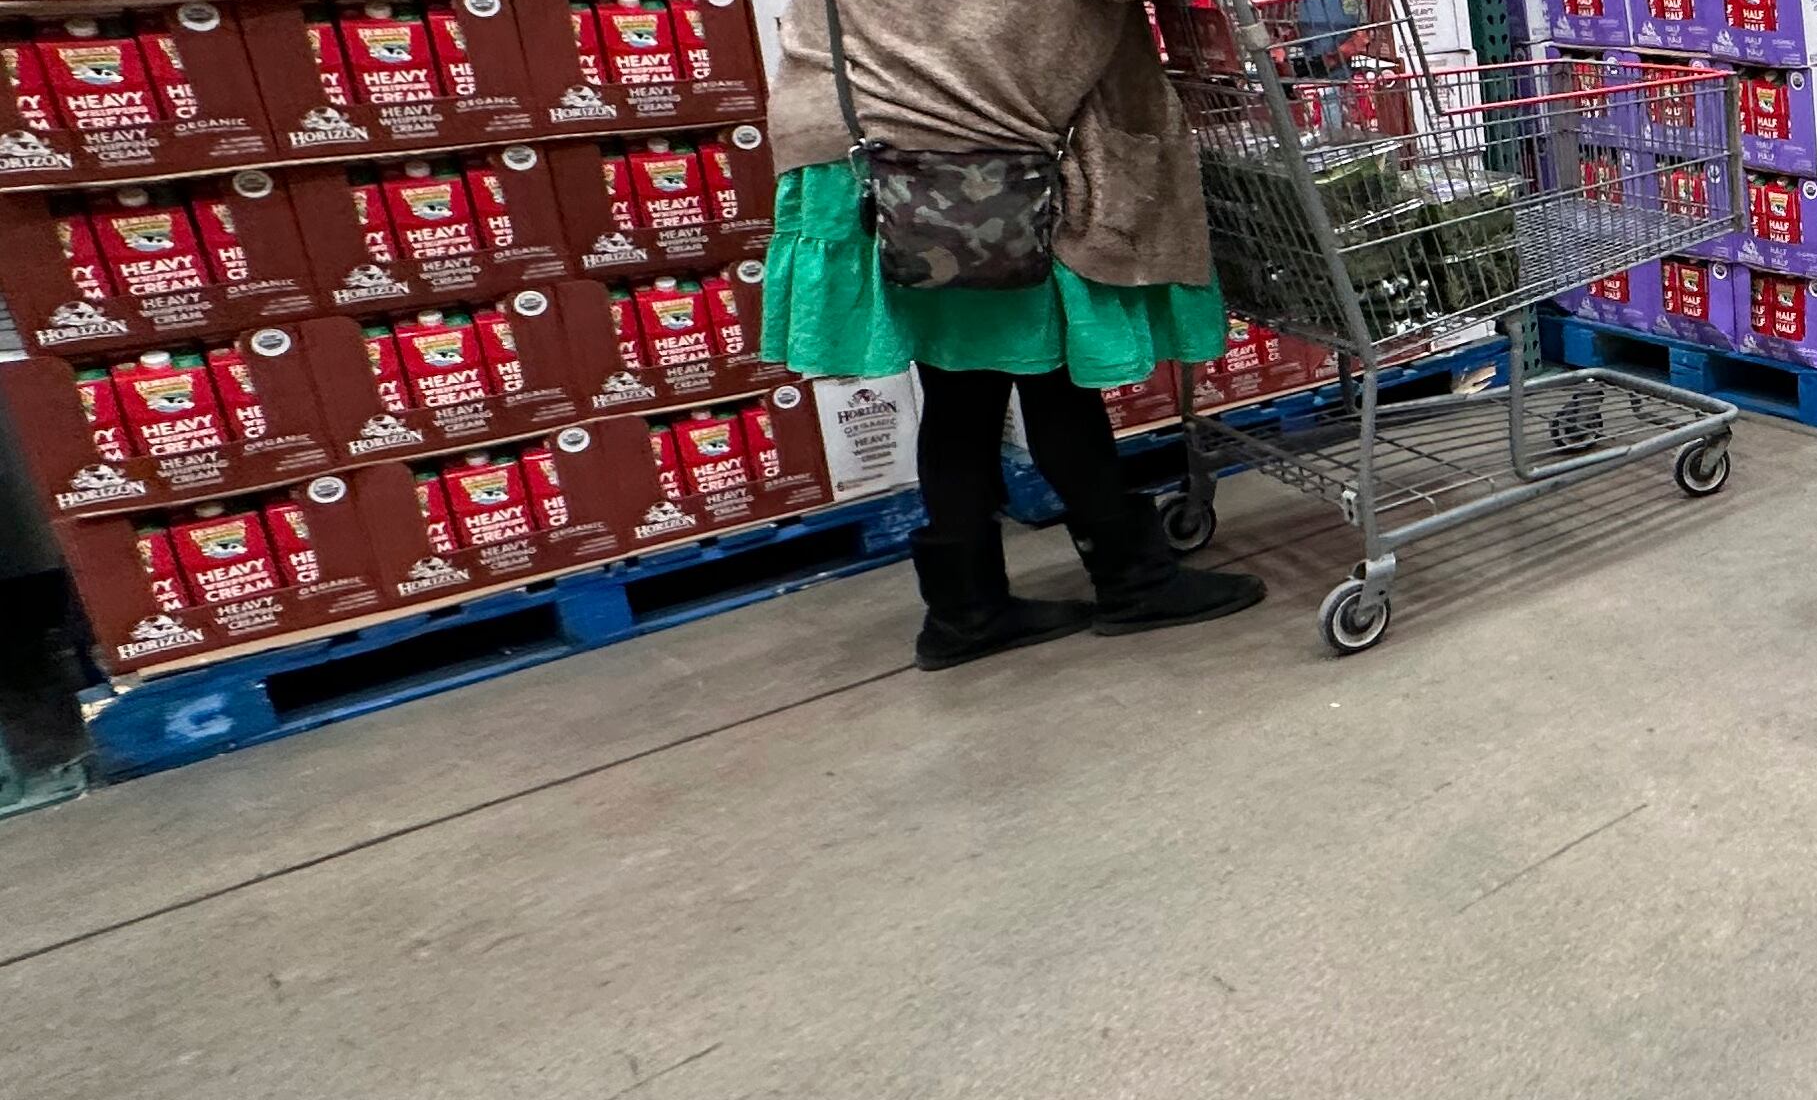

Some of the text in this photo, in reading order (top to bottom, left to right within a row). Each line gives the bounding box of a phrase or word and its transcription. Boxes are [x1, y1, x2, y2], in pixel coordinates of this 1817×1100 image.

[1665, 12, 1683, 20] HALF
[1743, 8, 1765, 20] HALF
[1744, 22, 1765, 32] HALF
[615, 53, 671, 68] HEAVY
[363, 69, 428, 85] HEAVY
[370, 91, 434, 103] CREAM
[629, 86, 674, 98] HEAVY
[66, 91, 145, 110] HEAVY
[456, 97, 518, 109] ORGANIC
[636, 102, 674, 111] CREAM
[381, 104, 434, 118] HEAVY
[549, 105, 617, 123] HORIZON
[76, 114, 152, 129] CREAM
[175, 117, 247, 132] ORGANIC
[378, 114, 443, 126] WHIPPING
[391, 123, 436, 133] CREAM
[1757, 116, 1777, 127] HALF
[84, 129, 147, 144] HEAVY
[289, 127, 369, 148] HORIZON
[1758, 129, 1778, 139] HALF
[99, 149, 151, 161] CREAM
[647, 196, 700, 211] HEAVY
[652, 215, 705, 228] CREAM
[1769, 220, 1790, 231] HALF
[406, 223, 468, 242] HEAVY
[659, 227, 703, 241] HEAVY
[1770, 232, 1790, 244] HALF
[120, 255, 193, 277] HEAVY
[422, 258, 472, 272] HEAVY
[582, 248, 649, 269] HORIZON
[129, 276, 203, 296] CREAM
[227, 278, 295, 295] ORGANIC
[1604, 280, 1620, 288] HALF
[141, 293, 201, 310] HEAVY
[1604, 290, 1620, 300] HALF
[1682, 295, 1701, 305] HALF
[1683, 307, 1702, 316] HALF
[1776, 310, 1796, 321] HALF
[1776, 323, 1796, 334] HALF
[654, 332, 706, 350] HEAVY
[660, 351, 711, 365] CREAM
[1227, 358, 1259, 372] CREAM
[667, 363, 710, 377] HEAVY
[417, 369, 480, 390] HEAVY
[425, 388, 487, 408] CREAM
[506, 387, 564, 403] ORGANIC
[435, 402, 485, 419] HEAVY
[837, 400, 897, 425] HORIZON
[140, 414, 214, 438] HEAVY
[444, 419, 486, 433] CREAM
[150, 435, 223, 457] CREAM
[243, 433, 311, 451] ORGANIC
[348, 429, 424, 455] HORIZON
[854, 433, 891, 447] HEAVY
[159, 451, 220, 470] HEAVY
[692, 456, 744, 478] HEAVY
[171, 469, 221, 485] CREAM
[698, 474, 747, 493] CREAM
[55, 480, 147, 510] HORIZON
[706, 488, 748, 505] HEAVY
[464, 505, 525, 529] HEAVY
[471, 524, 530, 545] CREAM
[550, 521, 605, 540] ORGANIC
[634, 513, 697, 540] HORIZON
[480, 539, 530, 558] HEAVY
[196, 557, 267, 585] HEAVY
[397, 569, 470, 596] HORIZON
[204, 579, 275, 603] CREAM
[216, 596, 275, 615] HEAVY
[228, 614, 276, 631] CREAM
[117, 628, 205, 661] HORIZON
